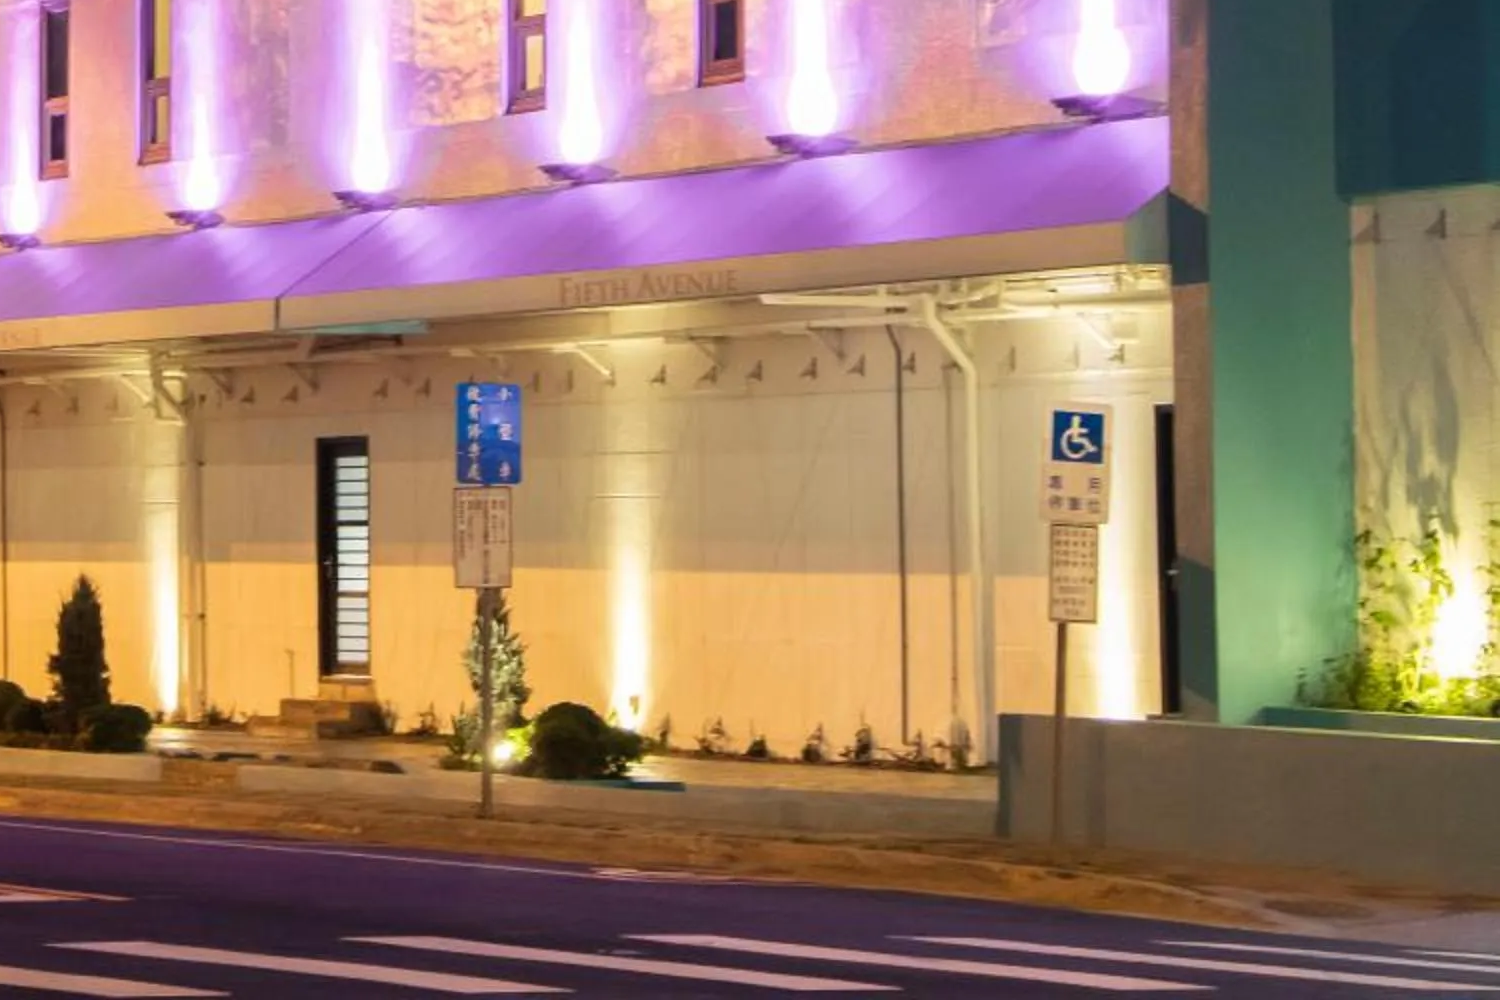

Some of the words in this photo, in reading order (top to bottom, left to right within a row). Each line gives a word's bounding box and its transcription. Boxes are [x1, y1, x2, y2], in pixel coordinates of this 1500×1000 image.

[636, 268, 739, 298] AVENUE
[497, 386, 513, 479] 小型車
